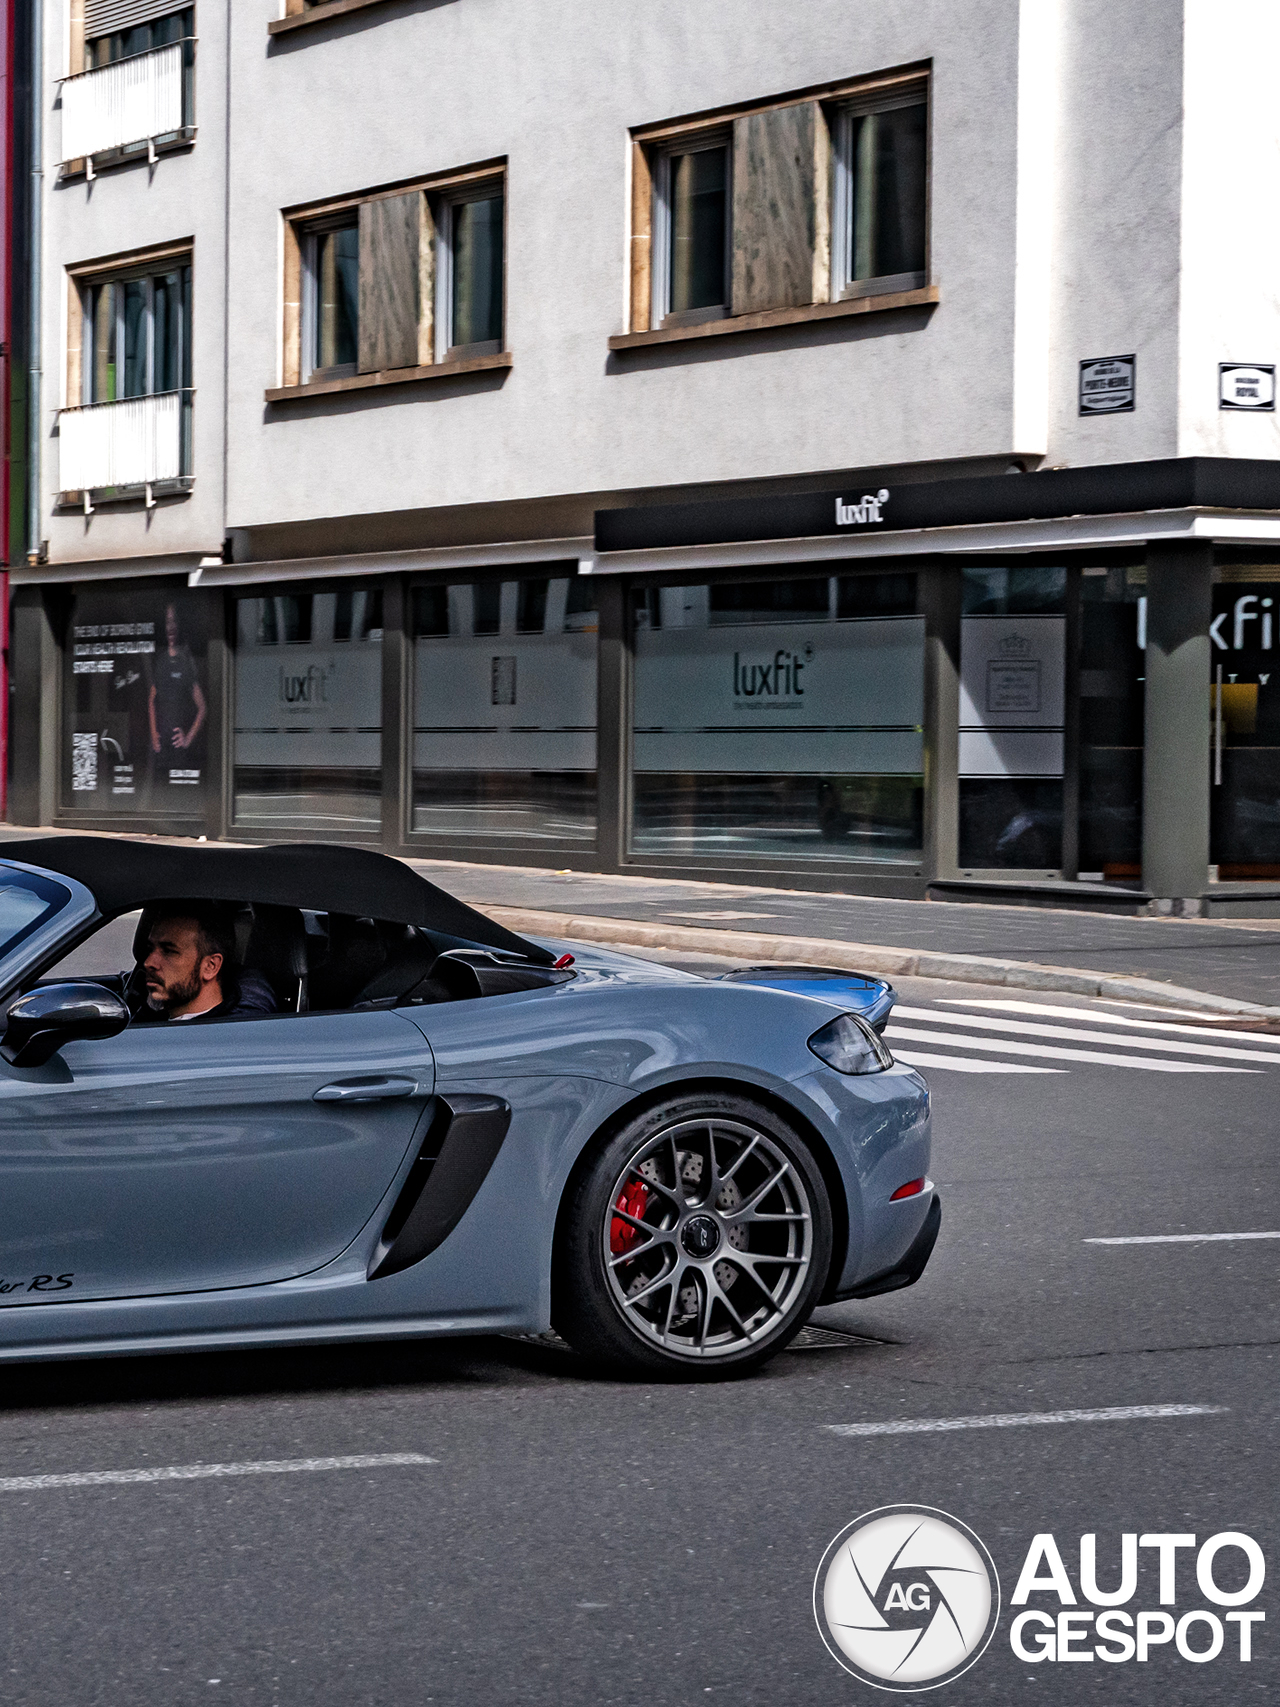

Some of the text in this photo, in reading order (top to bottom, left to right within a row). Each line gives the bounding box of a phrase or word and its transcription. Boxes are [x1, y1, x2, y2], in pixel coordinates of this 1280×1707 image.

[835, 494, 884, 525] luxfit
[1137, 595, 1280, 650] lxfi
[279, 664, 329, 703] luxfit
[733, 649, 804, 696] luxfit
[27, 1273, 75, 1292] RS
